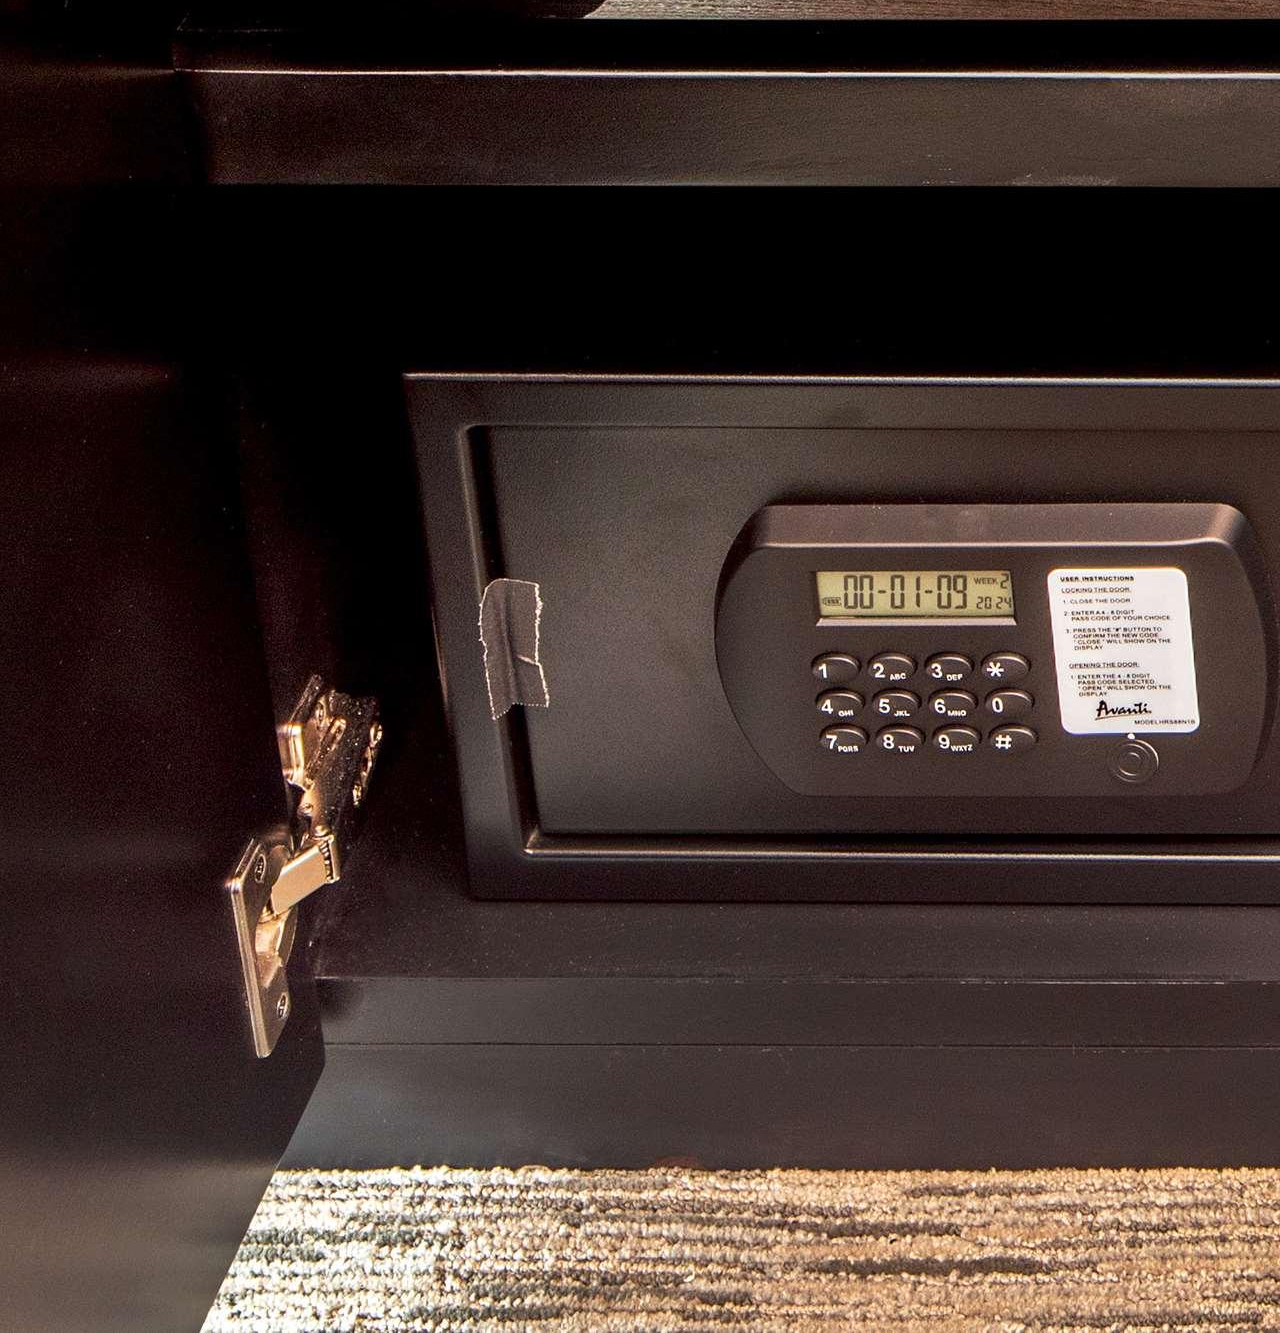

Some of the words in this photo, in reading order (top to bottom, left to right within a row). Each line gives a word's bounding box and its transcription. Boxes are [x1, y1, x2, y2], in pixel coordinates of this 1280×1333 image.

[974, 577, 997, 585] WEEK
[1000, 573, 1010, 589] 2
[844, 574, 967, 609] 00-01-09
[818, 664, 827, 678] 1
[873, 663, 885, 678] 2
[931, 663, 943, 678] 3
[946, 673, 963, 681] DEF
[821, 700, 833, 714] 4
[878, 699, 890, 713] 5
[934, 699, 945, 713] 6
[992, 698, 1003, 713] 0
[826, 735, 838, 749] 7
[883, 734, 894, 749] 8
[938, 734, 950, 749] 9
[951, 744, 973, 752] WXYZ
[995, 735, 1012, 749] #
